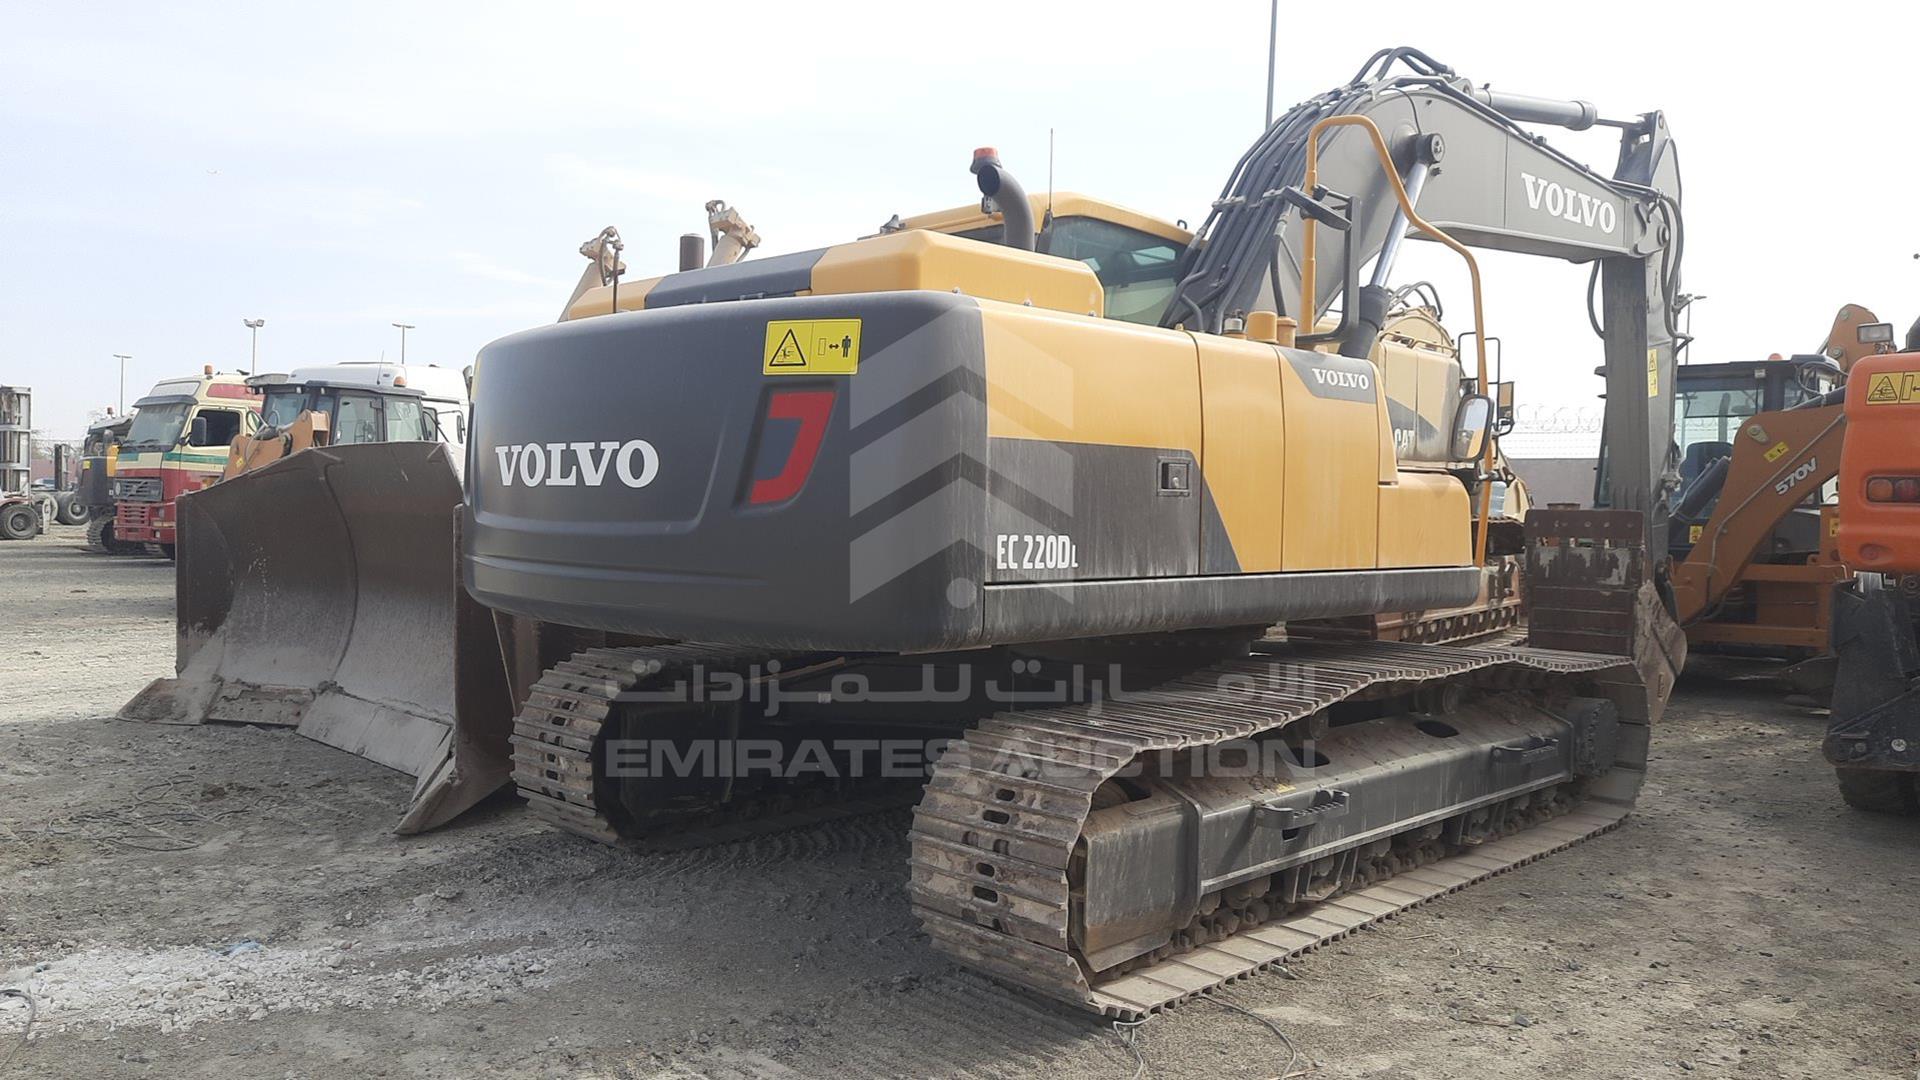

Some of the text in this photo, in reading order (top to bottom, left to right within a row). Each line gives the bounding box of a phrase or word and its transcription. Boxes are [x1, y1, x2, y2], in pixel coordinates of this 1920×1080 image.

[1521, 172, 1616, 234] VOLVO
[1311, 367, 1369, 390] VOLVO
[495, 439, 659, 488] VOLVO
[997, 534, 1019, 569] EC
